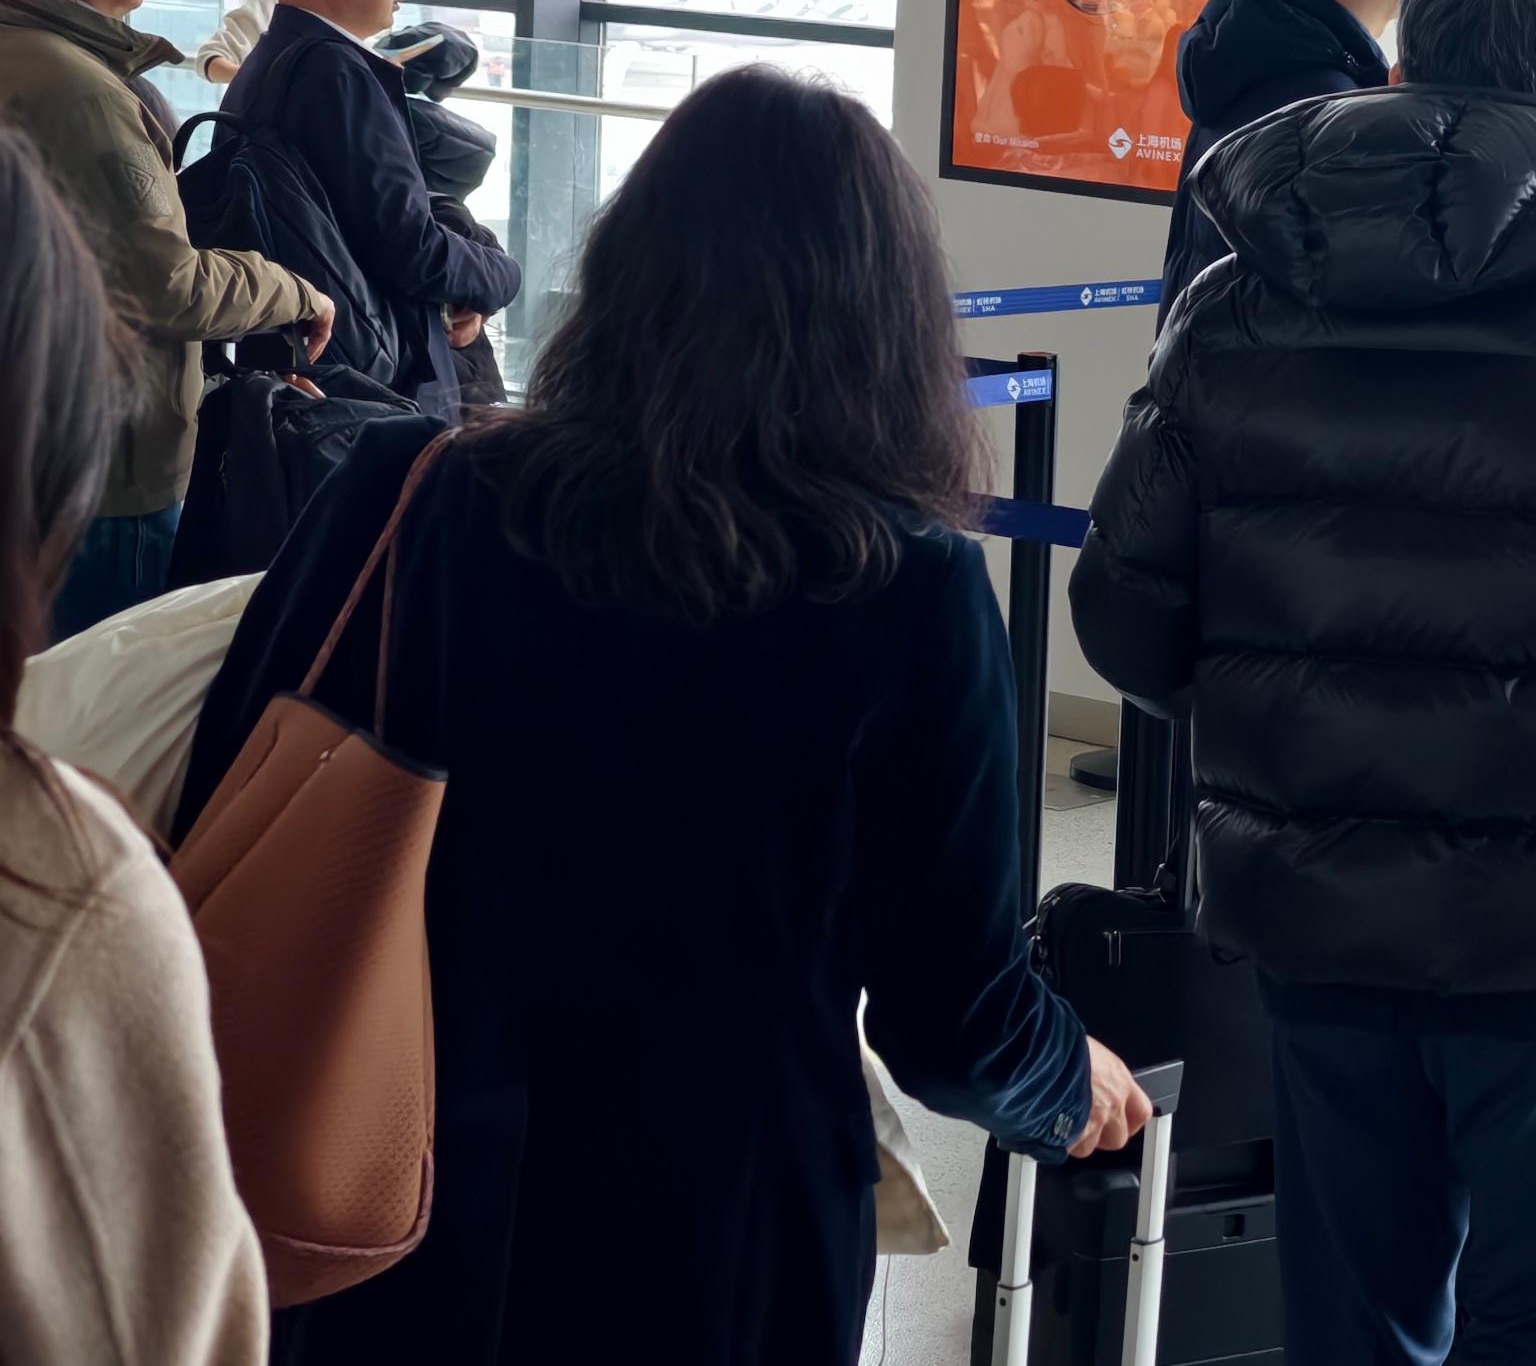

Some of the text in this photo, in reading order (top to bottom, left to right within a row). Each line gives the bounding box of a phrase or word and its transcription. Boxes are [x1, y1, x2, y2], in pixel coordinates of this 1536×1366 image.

[1135, 133, 1182, 151] 上海机场
[1135, 148, 1181, 162] AVINEX
